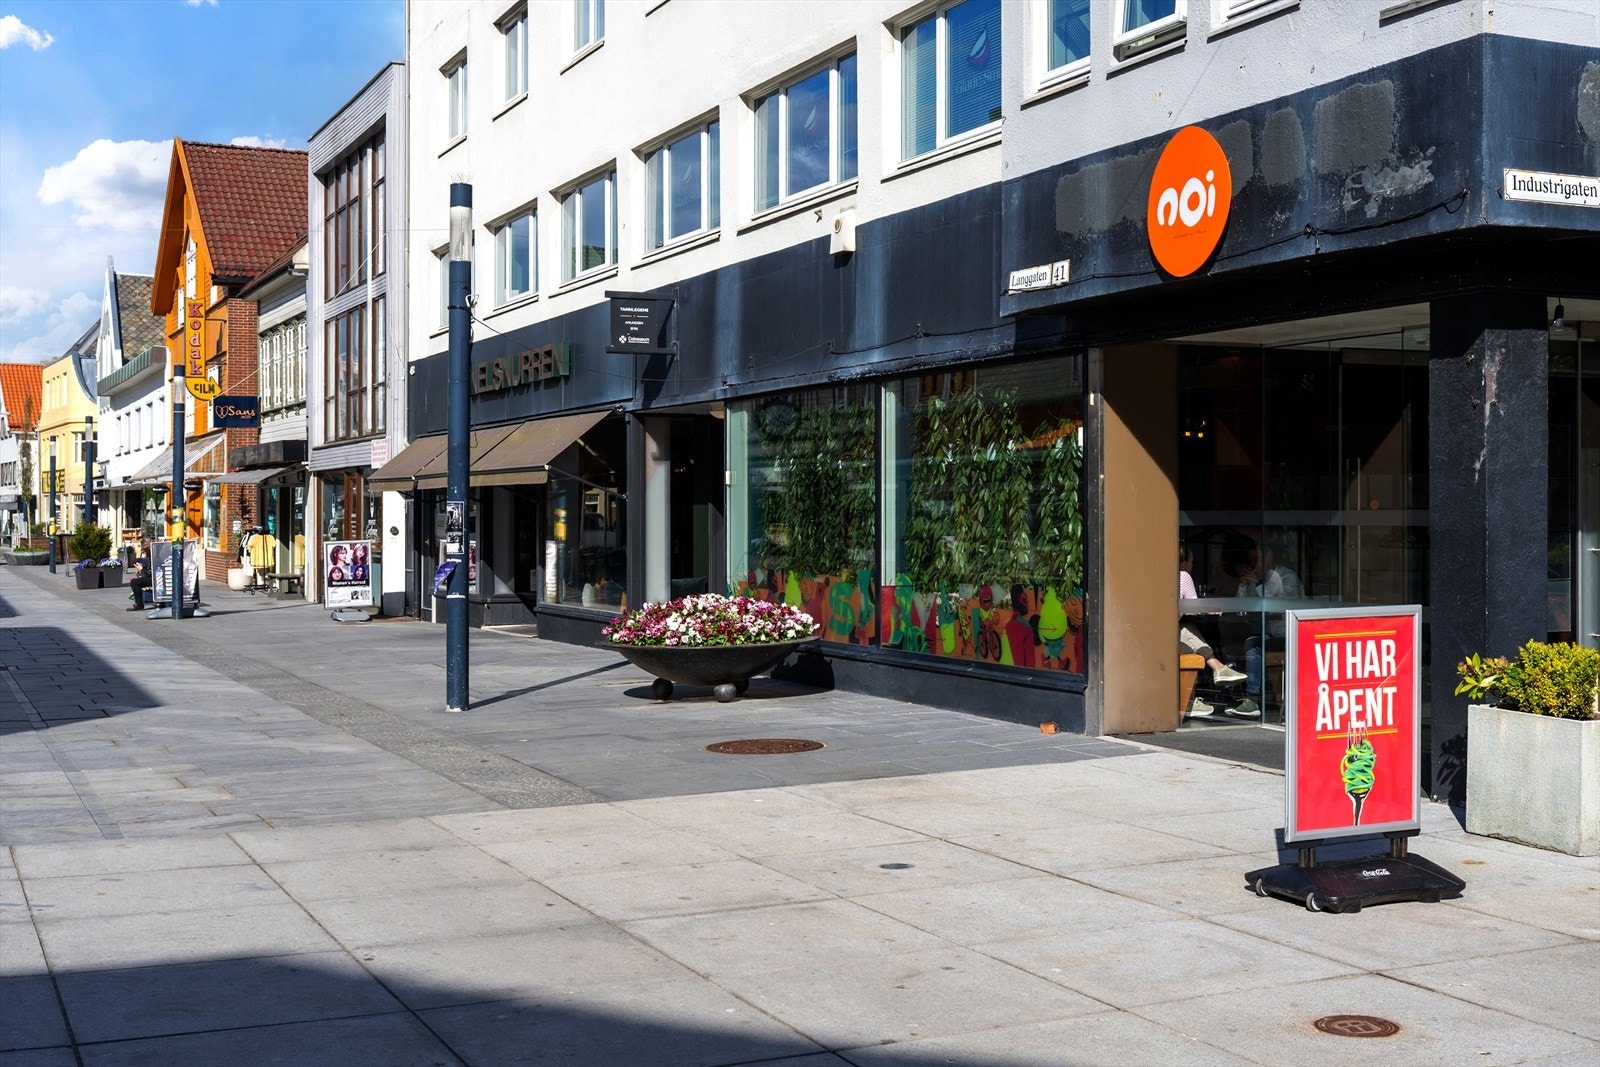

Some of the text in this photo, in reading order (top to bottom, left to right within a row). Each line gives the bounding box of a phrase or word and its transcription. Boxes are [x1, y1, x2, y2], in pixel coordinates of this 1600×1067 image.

[1157, 169, 1216, 227] noi
[1512, 174, 1598, 199] Industrigaten
[1011, 265, 1065, 287] Langgaten 41
[188, 303, 203, 375] Kodak
[470, 341, 570, 394] NELSNURREN
[228, 406, 256, 416] Sans
[1315, 639, 1397, 681] VI HAR
[1315, 683, 1397, 731] ÅPENT
